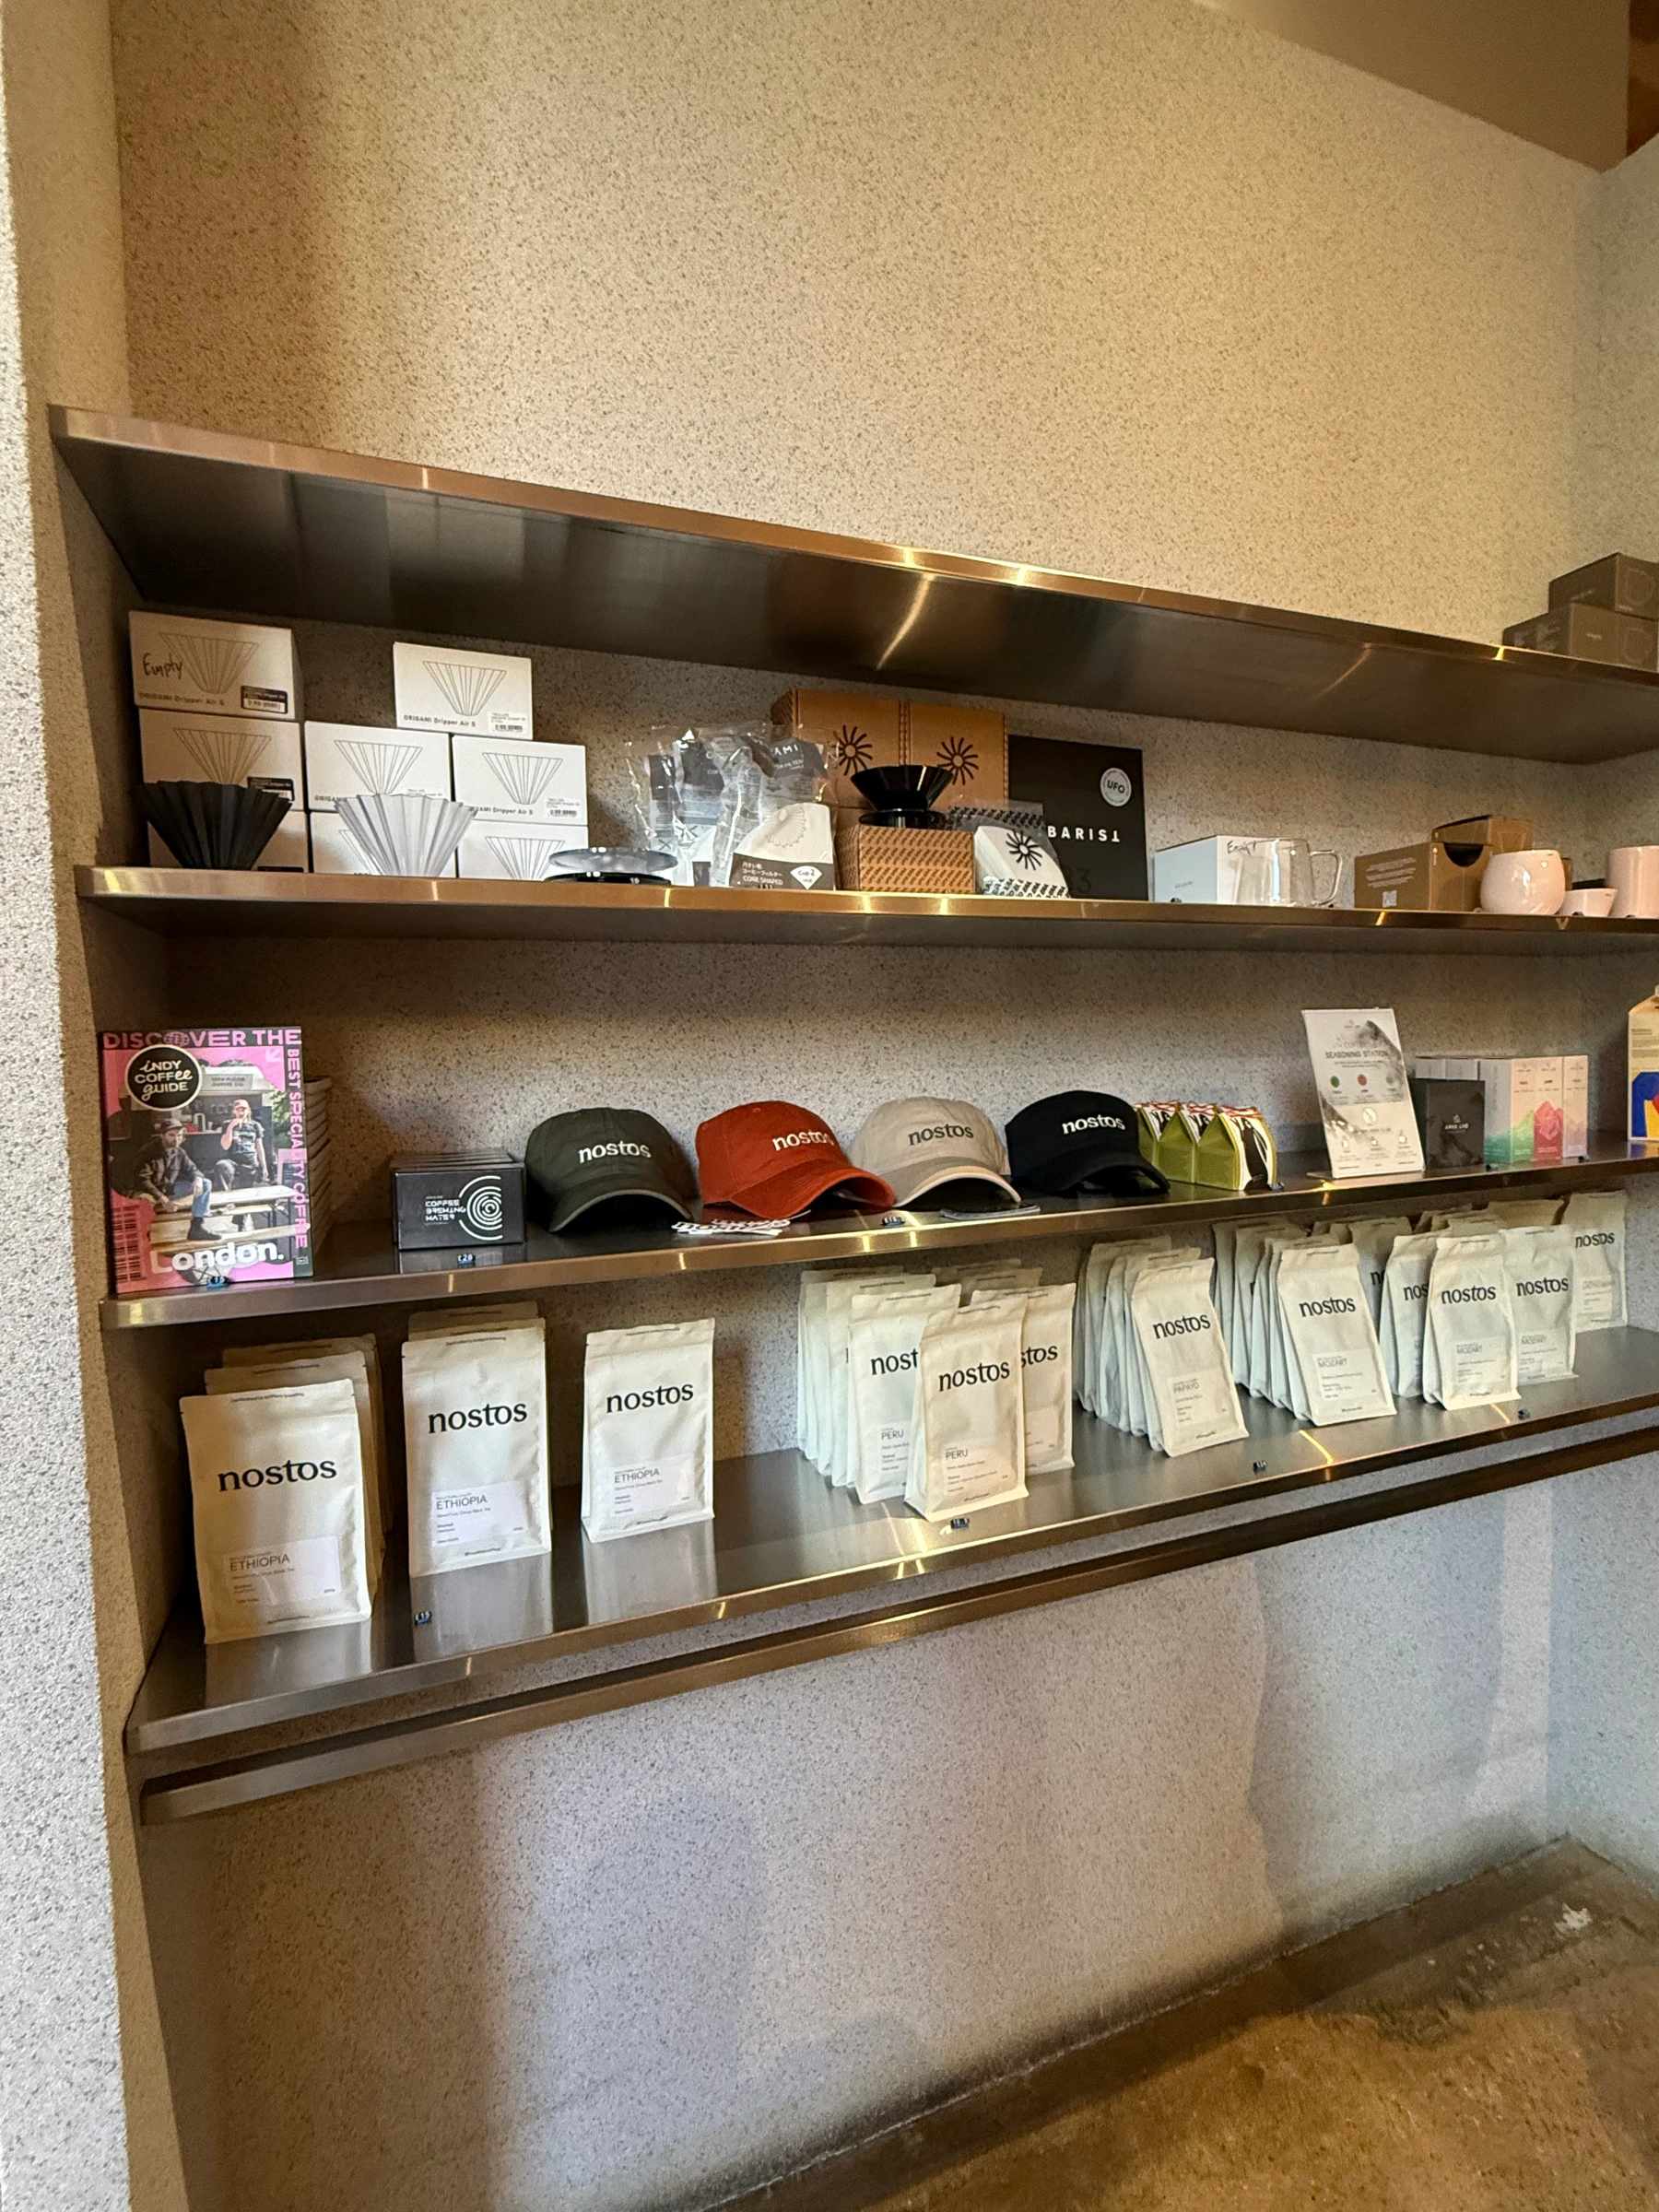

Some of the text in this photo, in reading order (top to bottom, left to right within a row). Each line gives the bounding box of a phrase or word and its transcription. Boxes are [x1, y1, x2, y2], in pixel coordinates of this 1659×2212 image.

[404, 714, 431, 723] ORIGAMI
[434, 717, 458, 726] Dripper
[1107, 779, 1124, 794] UFO
[493, 806, 516, 815] Dripper
[253, 1030, 302, 1045] THE
[288, 1048, 301, 1088] BEST
[1062, 1113, 1125, 1135] nostos
[771, 1129, 835, 1151] nostos
[908, 1124, 973, 1146] nostos
[579, 1140, 652, 1163] nostos
[293, 1182, 309, 1248] COFFEE
[1441, 1285, 1497, 1305] nostos
[1516, 1277, 1569, 1297] nostos
[1299, 1297, 1357, 1318] nostos
[1153, 1313, 1211, 1339] nostos
[870, 1347, 919, 1376] nost
[938, 1361, 1010, 1392] nostos
[606, 1383, 694, 1413] nostos
[428, 1403, 527, 1433] nostos
[881, 1430, 904, 1441] PERU
[946, 1449, 969, 1461] PERU
[218, 1459, 337, 1492] nostos
[614, 1468, 660, 1484] ETHIOPIA
[436, 1494, 488, 1511] ETHIOPIA
[230, 1553, 290, 1572] ETHIOPIA
